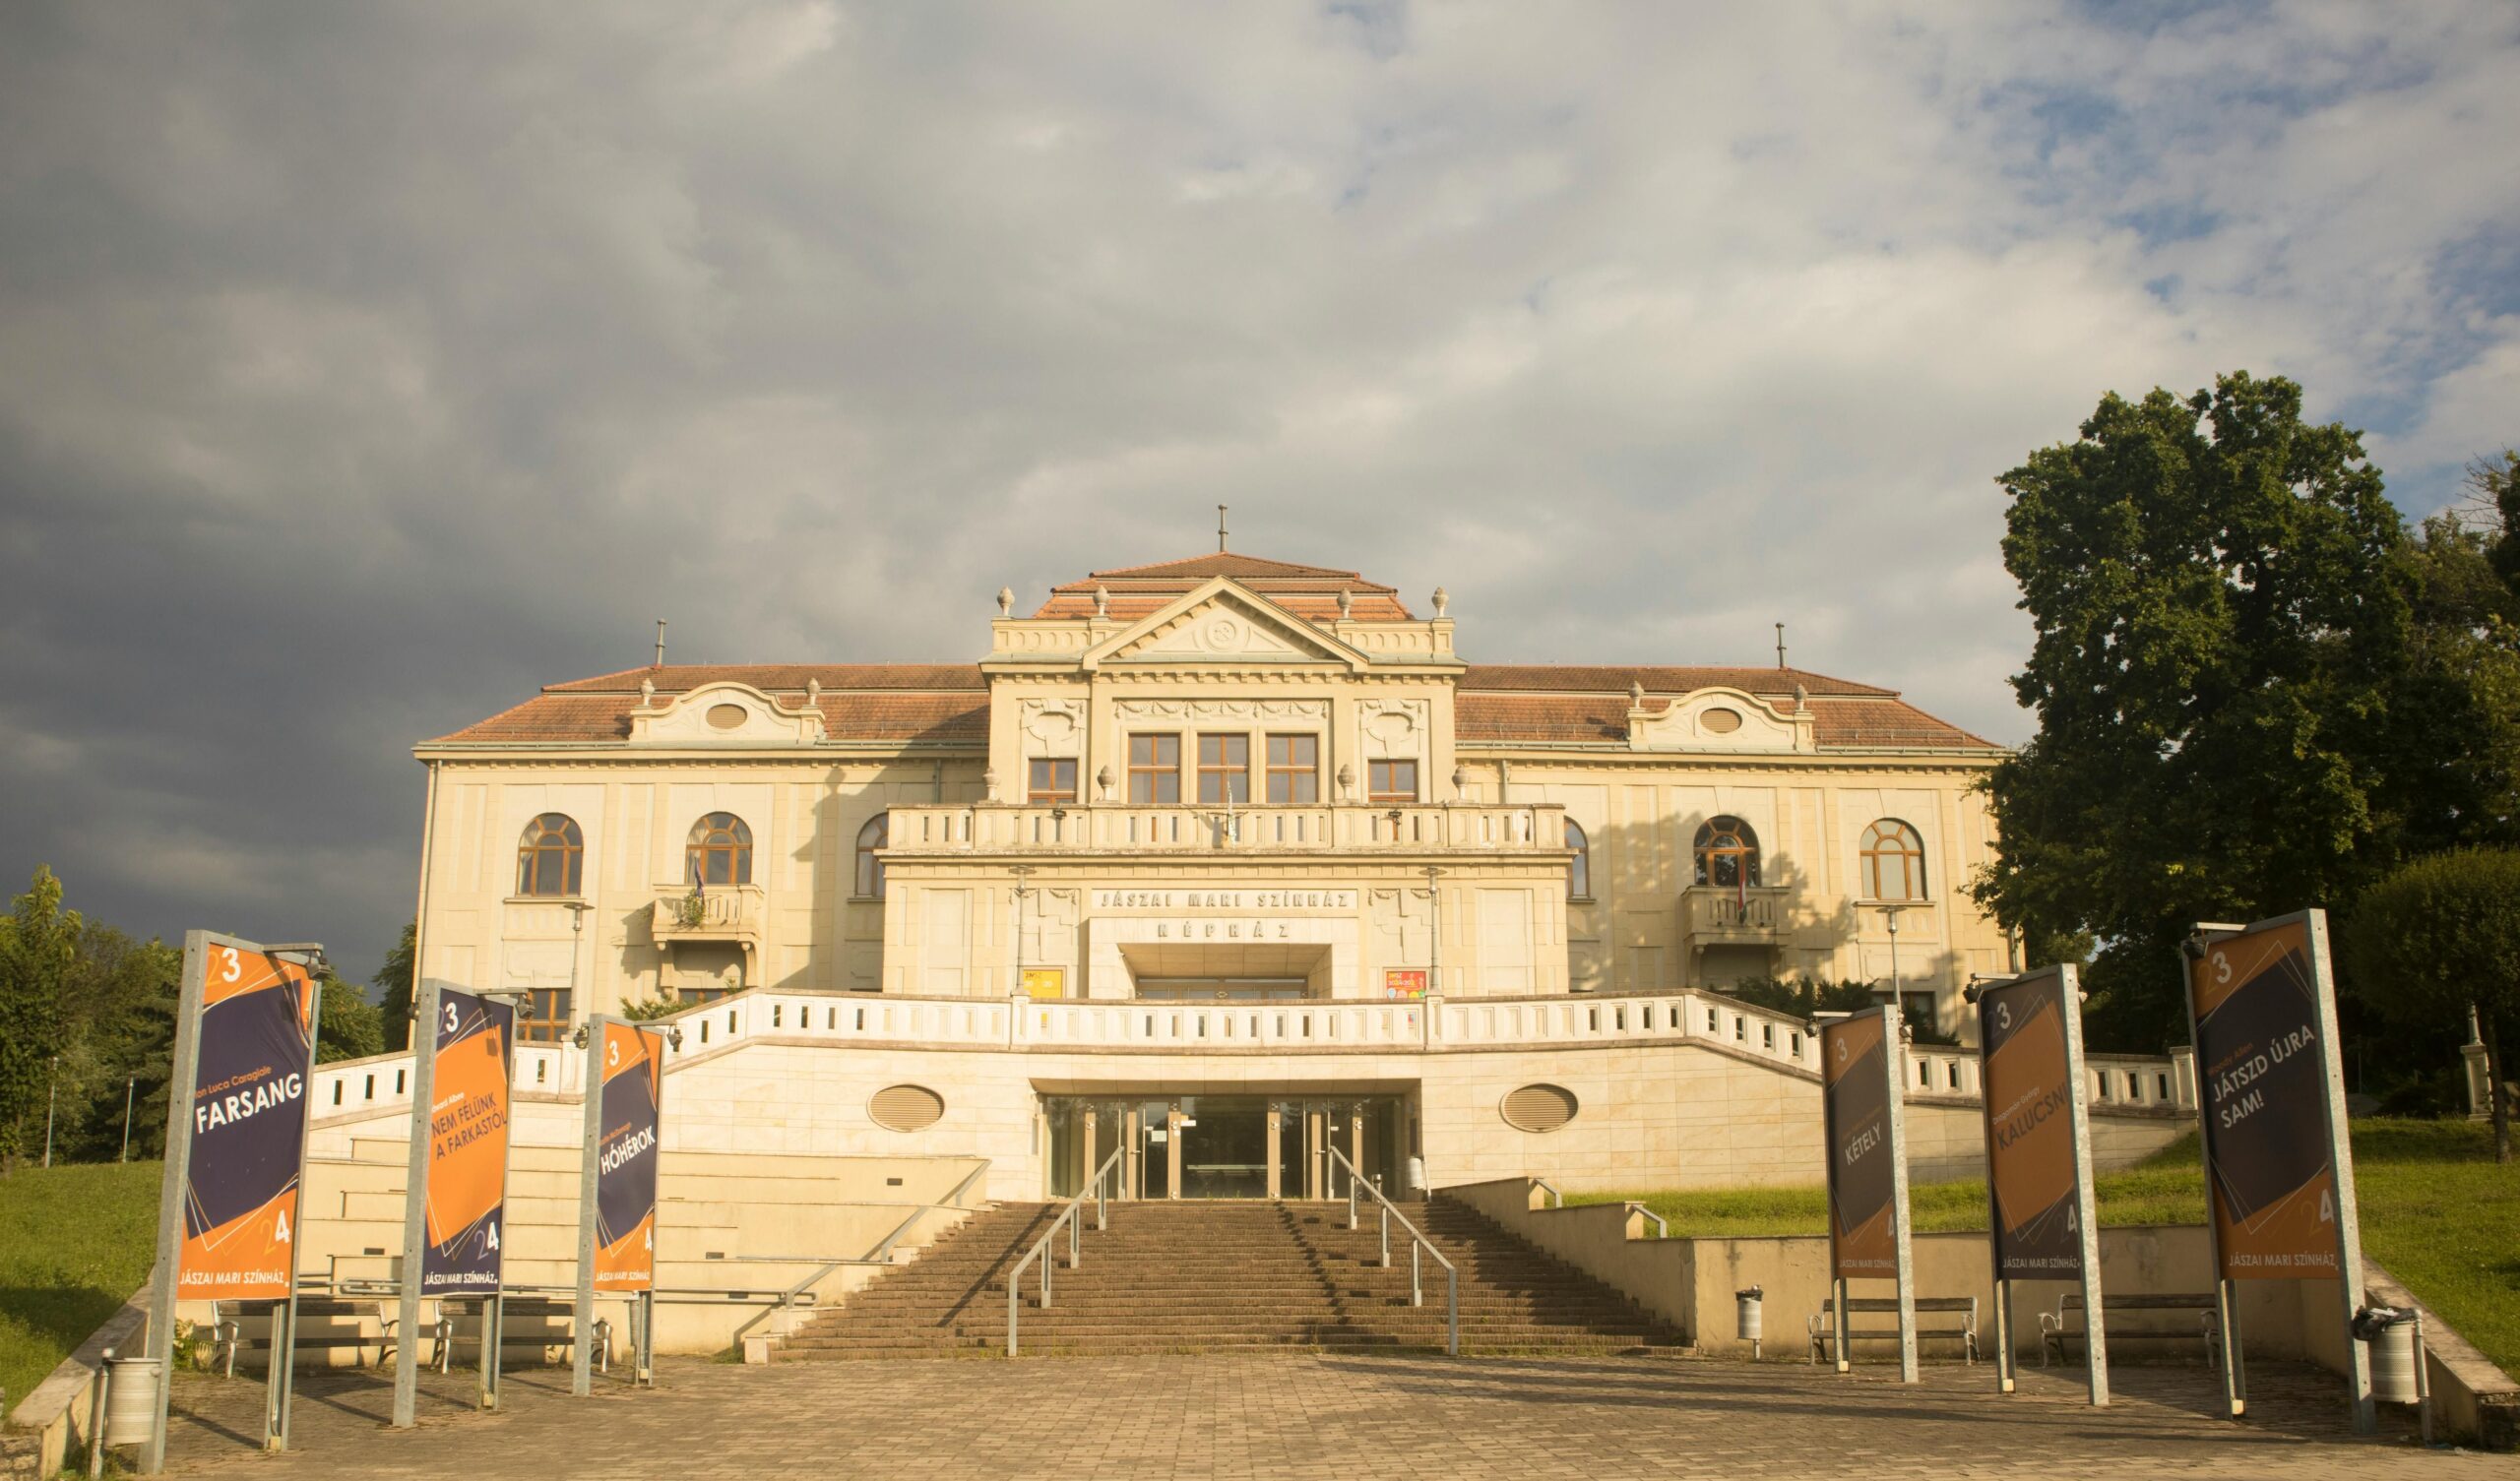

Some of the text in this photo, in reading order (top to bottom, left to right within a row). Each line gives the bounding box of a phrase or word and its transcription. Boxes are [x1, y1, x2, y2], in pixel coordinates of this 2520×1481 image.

[1101, 891, 1349, 907] JÁSZAI MARI SZÍNHÁZ
[1158, 921, 1289, 938] NÉPHÁZ
[209, 1081, 229, 1095] Luca
[231, 1066, 272, 1086] Caragiale
[2214, 1024, 2315, 1102] JÁTSZD ÚJRA
[196, 1073, 303, 1134] FARSANG
[431, 1092, 497, 1139] NEM FÉLÜNK
[2220, 1088, 2265, 1129] SAM!
[436, 1108, 508, 1160] A FARKASTÓL
[600, 1126, 657, 1175] HÓHÉROK
[1845, 1122, 1881, 1165] KÉTELY
[180, 1268, 214, 1284] JÁSZAI
[217, 1271, 241, 1284] MARI
[2003, 1256, 2028, 1268] JÁSZAI
[2029, 1258, 2048, 1268] MARI
[2229, 1252, 2262, 1266] JÁSZAI
[2264, 1254, 2292, 1266] MARI
[424, 1270, 446, 1285] JÁSZAI
